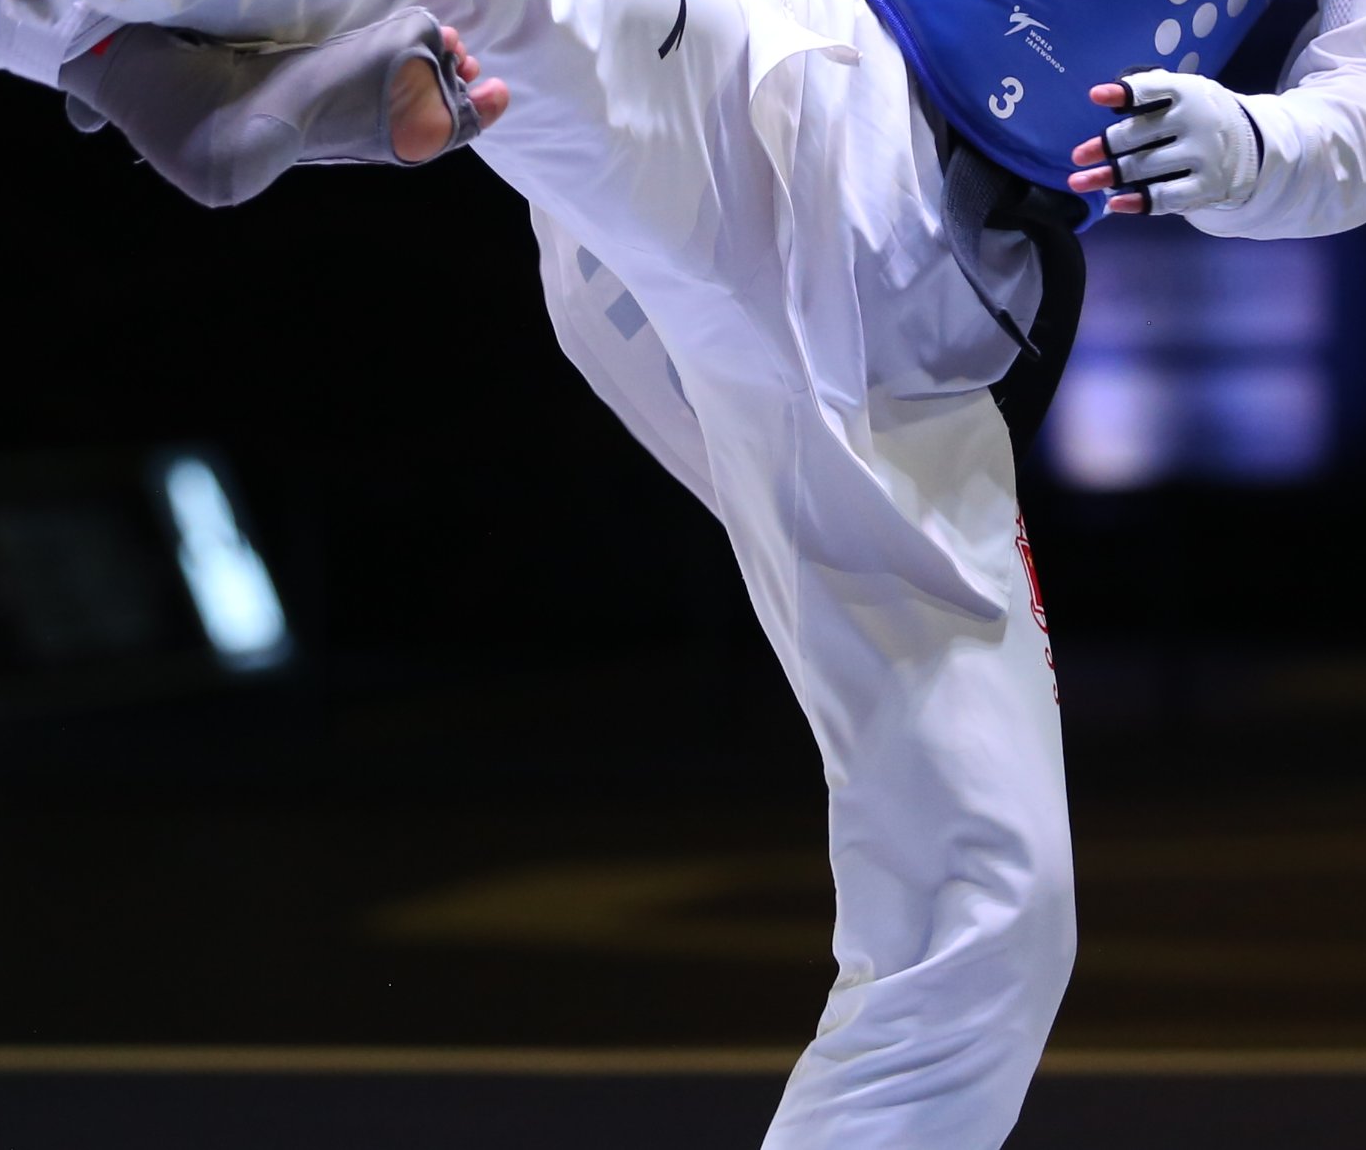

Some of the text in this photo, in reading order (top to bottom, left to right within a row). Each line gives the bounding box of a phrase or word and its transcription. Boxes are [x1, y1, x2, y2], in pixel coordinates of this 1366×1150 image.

[1025, 36, 1065, 73] TAEKWONDO
[1030, 29, 1053, 51] WORLD
[988, 76, 1024, 119] 3
